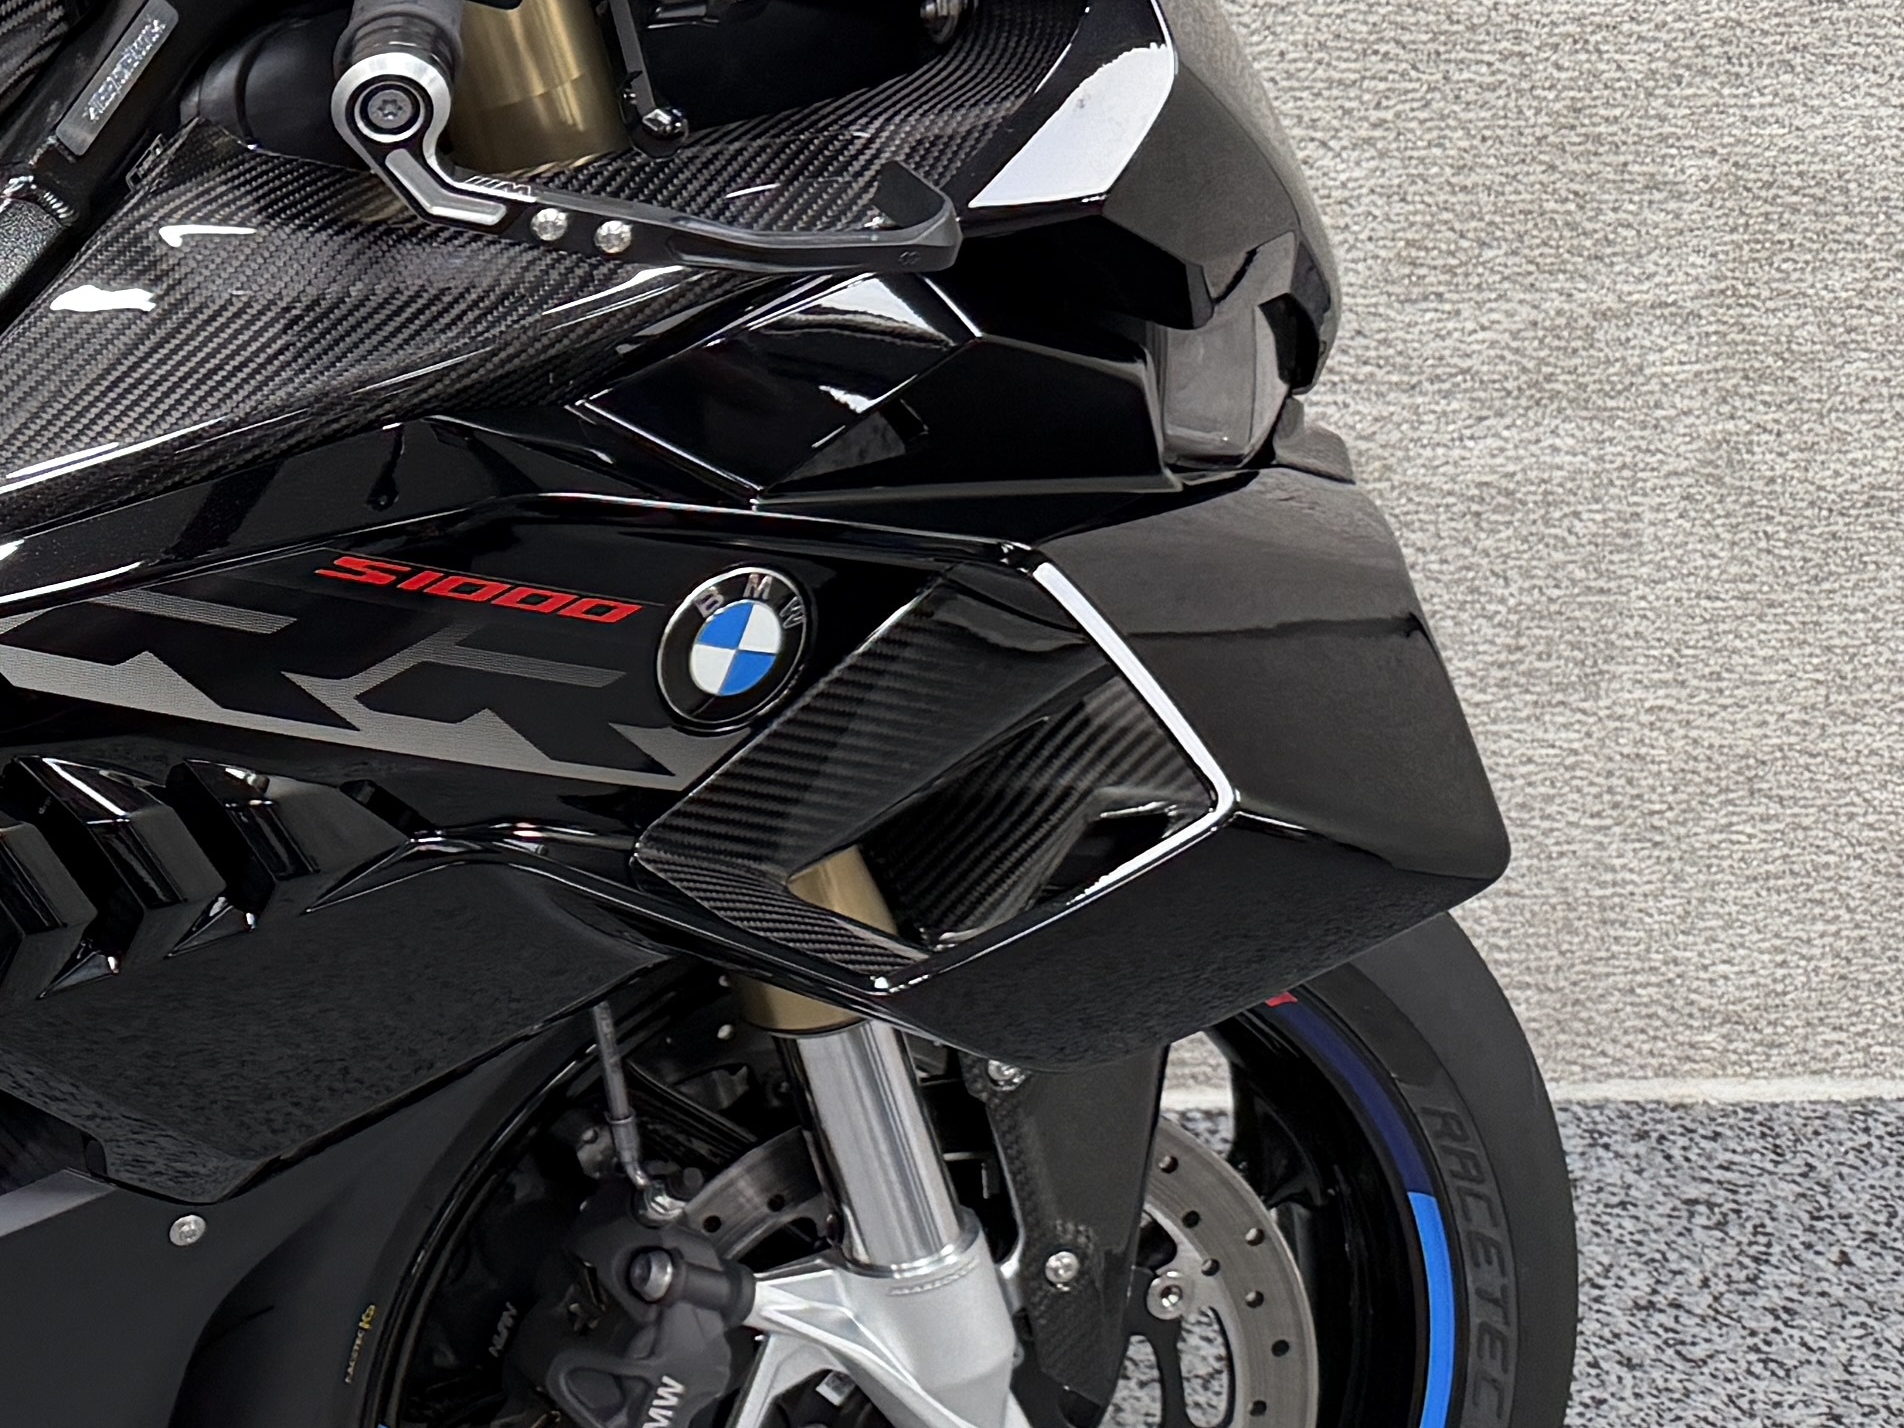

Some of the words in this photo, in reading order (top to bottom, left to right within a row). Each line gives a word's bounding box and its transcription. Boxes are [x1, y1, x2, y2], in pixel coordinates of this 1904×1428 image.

[316, 555, 644, 624] S1000
[694, 572, 807, 630] BMW
[1421, 1104, 1512, 1422] RACETEC
